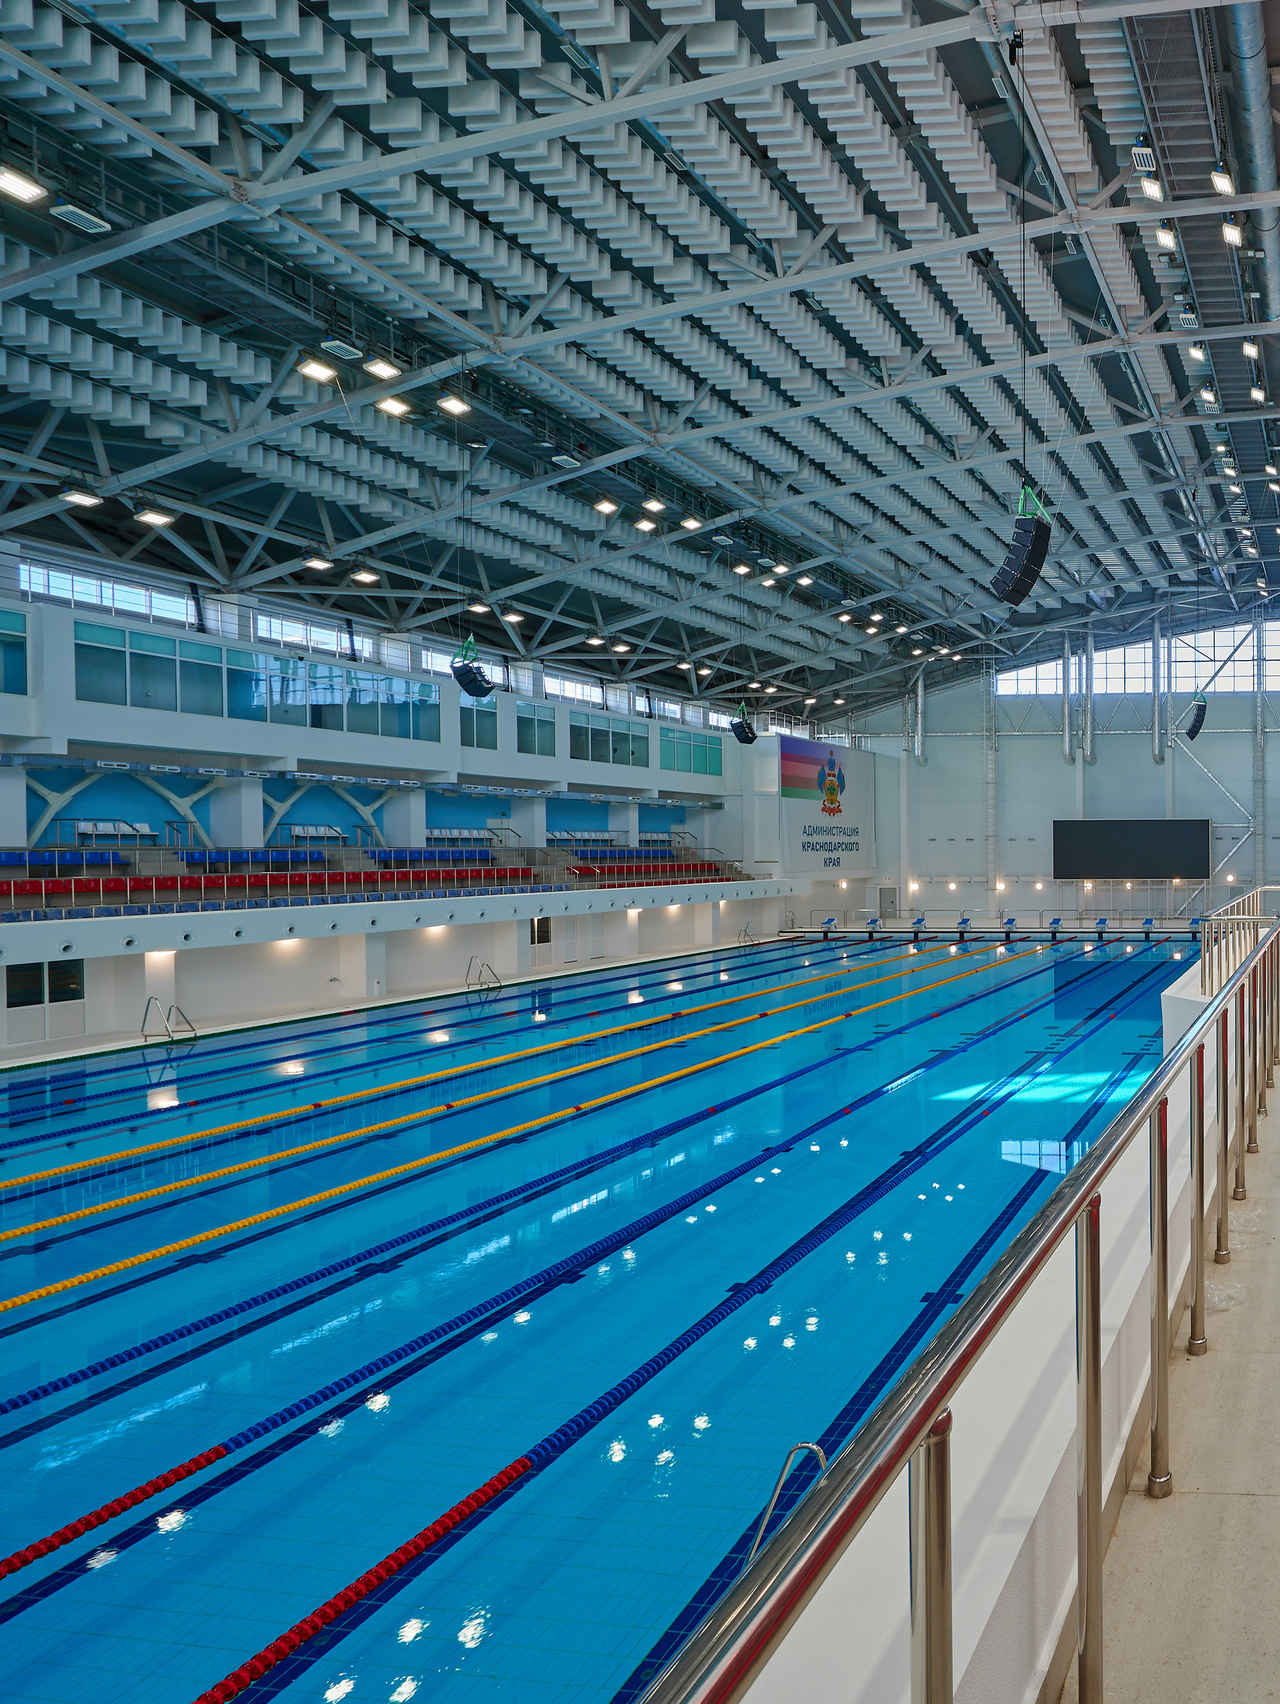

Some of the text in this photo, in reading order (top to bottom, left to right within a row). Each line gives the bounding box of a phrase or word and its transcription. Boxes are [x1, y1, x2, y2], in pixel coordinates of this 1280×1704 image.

[802, 825, 859, 838] АДМИНИСТРАЦИЯ
[801, 841, 860, 853] КРАСНОДАРСКОГО
[823, 857, 841, 867] КРАЯ
